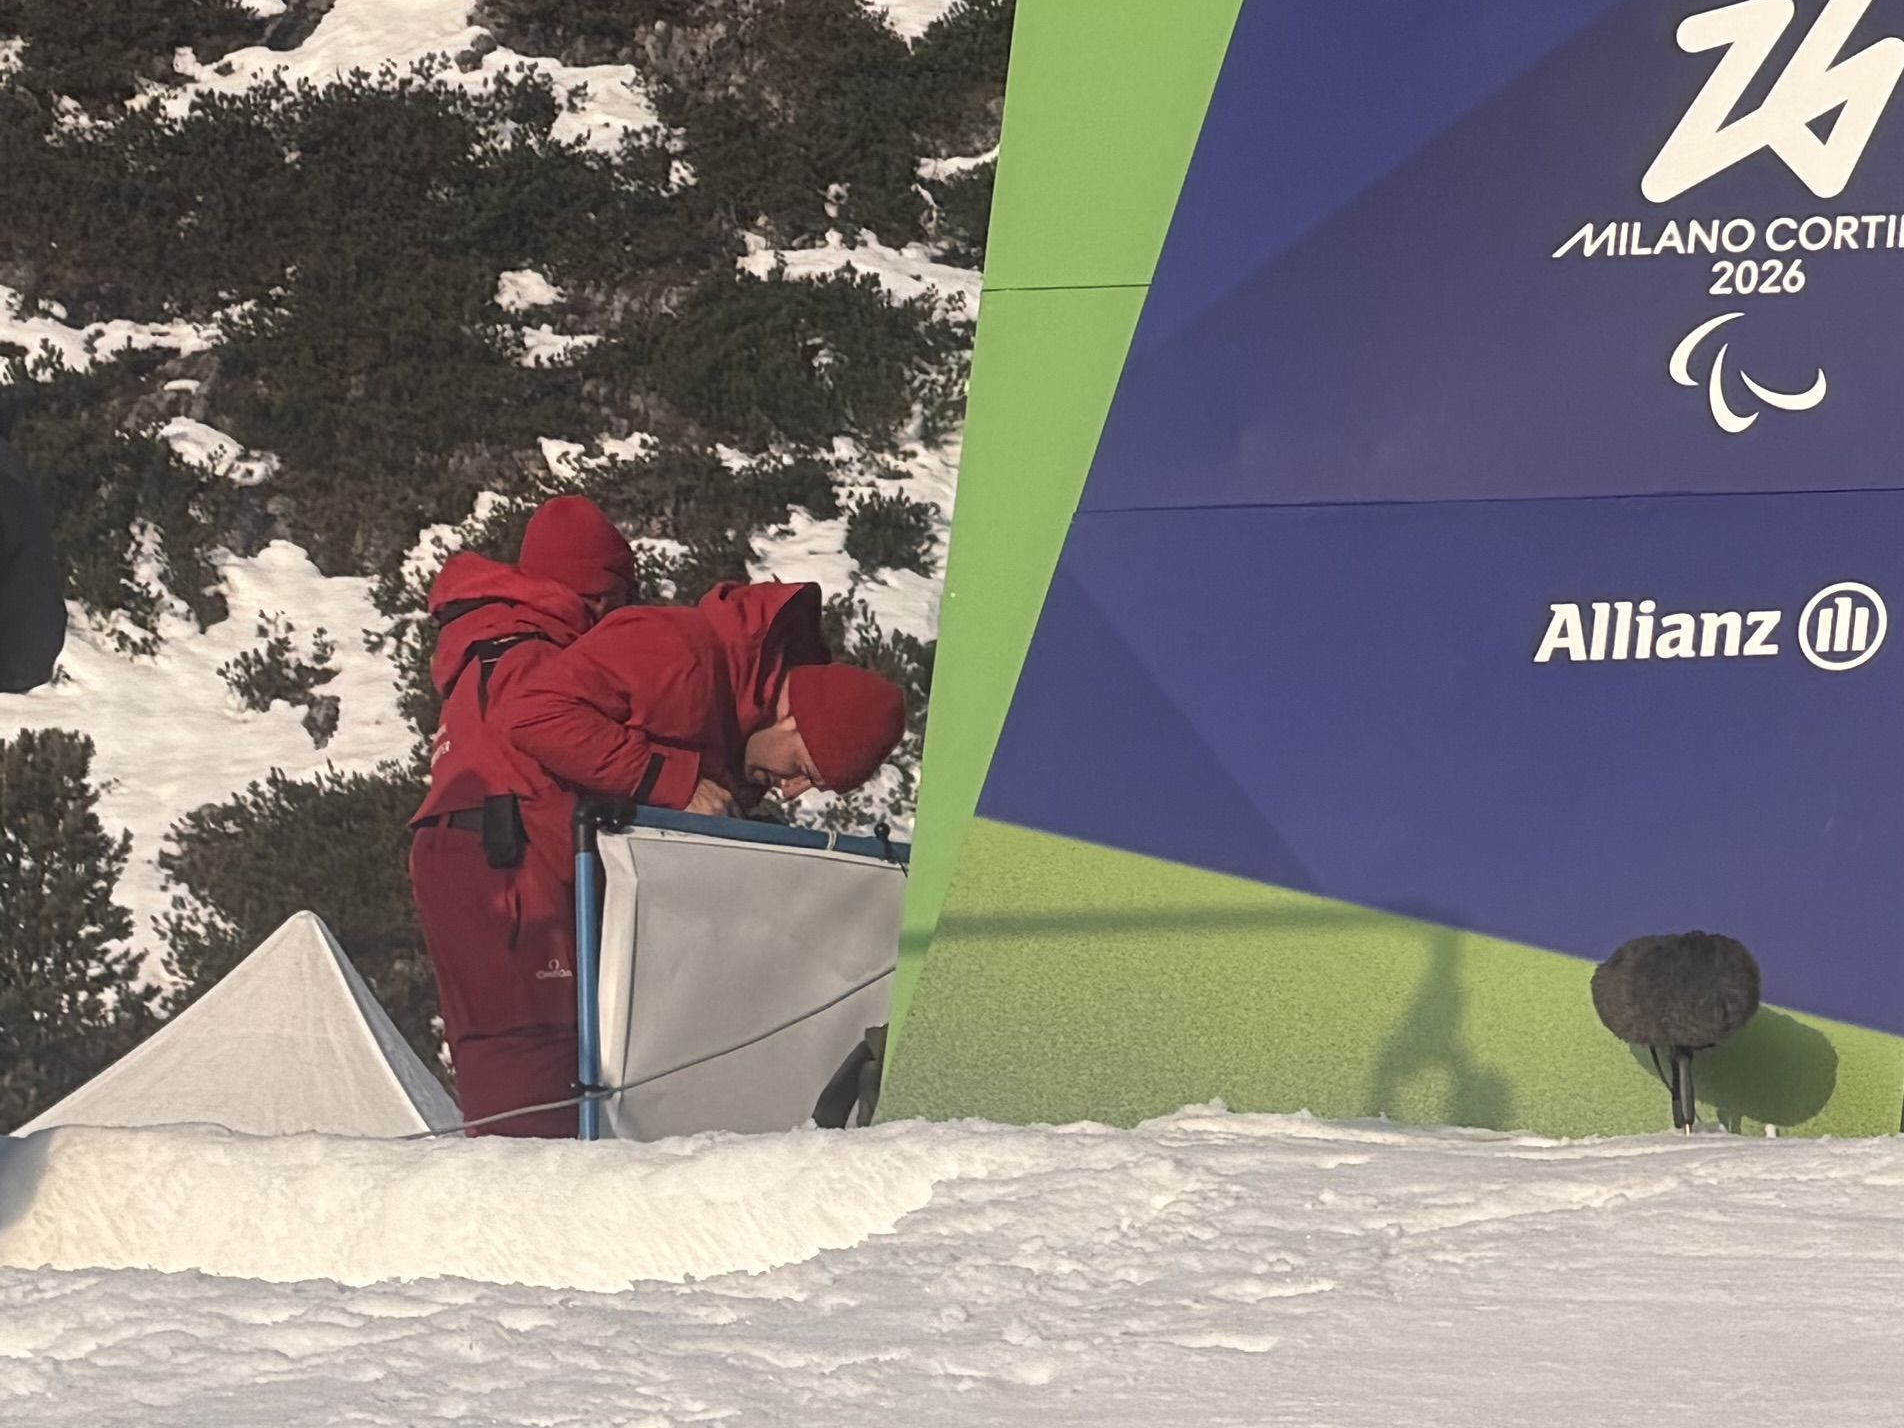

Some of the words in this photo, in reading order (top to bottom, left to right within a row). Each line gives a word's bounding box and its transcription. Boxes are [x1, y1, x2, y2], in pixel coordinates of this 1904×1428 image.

[1551, 218, 1756, 258] MILANO
[1708, 258, 1806, 295] 2026
[1533, 599, 1782, 663] Allianz
